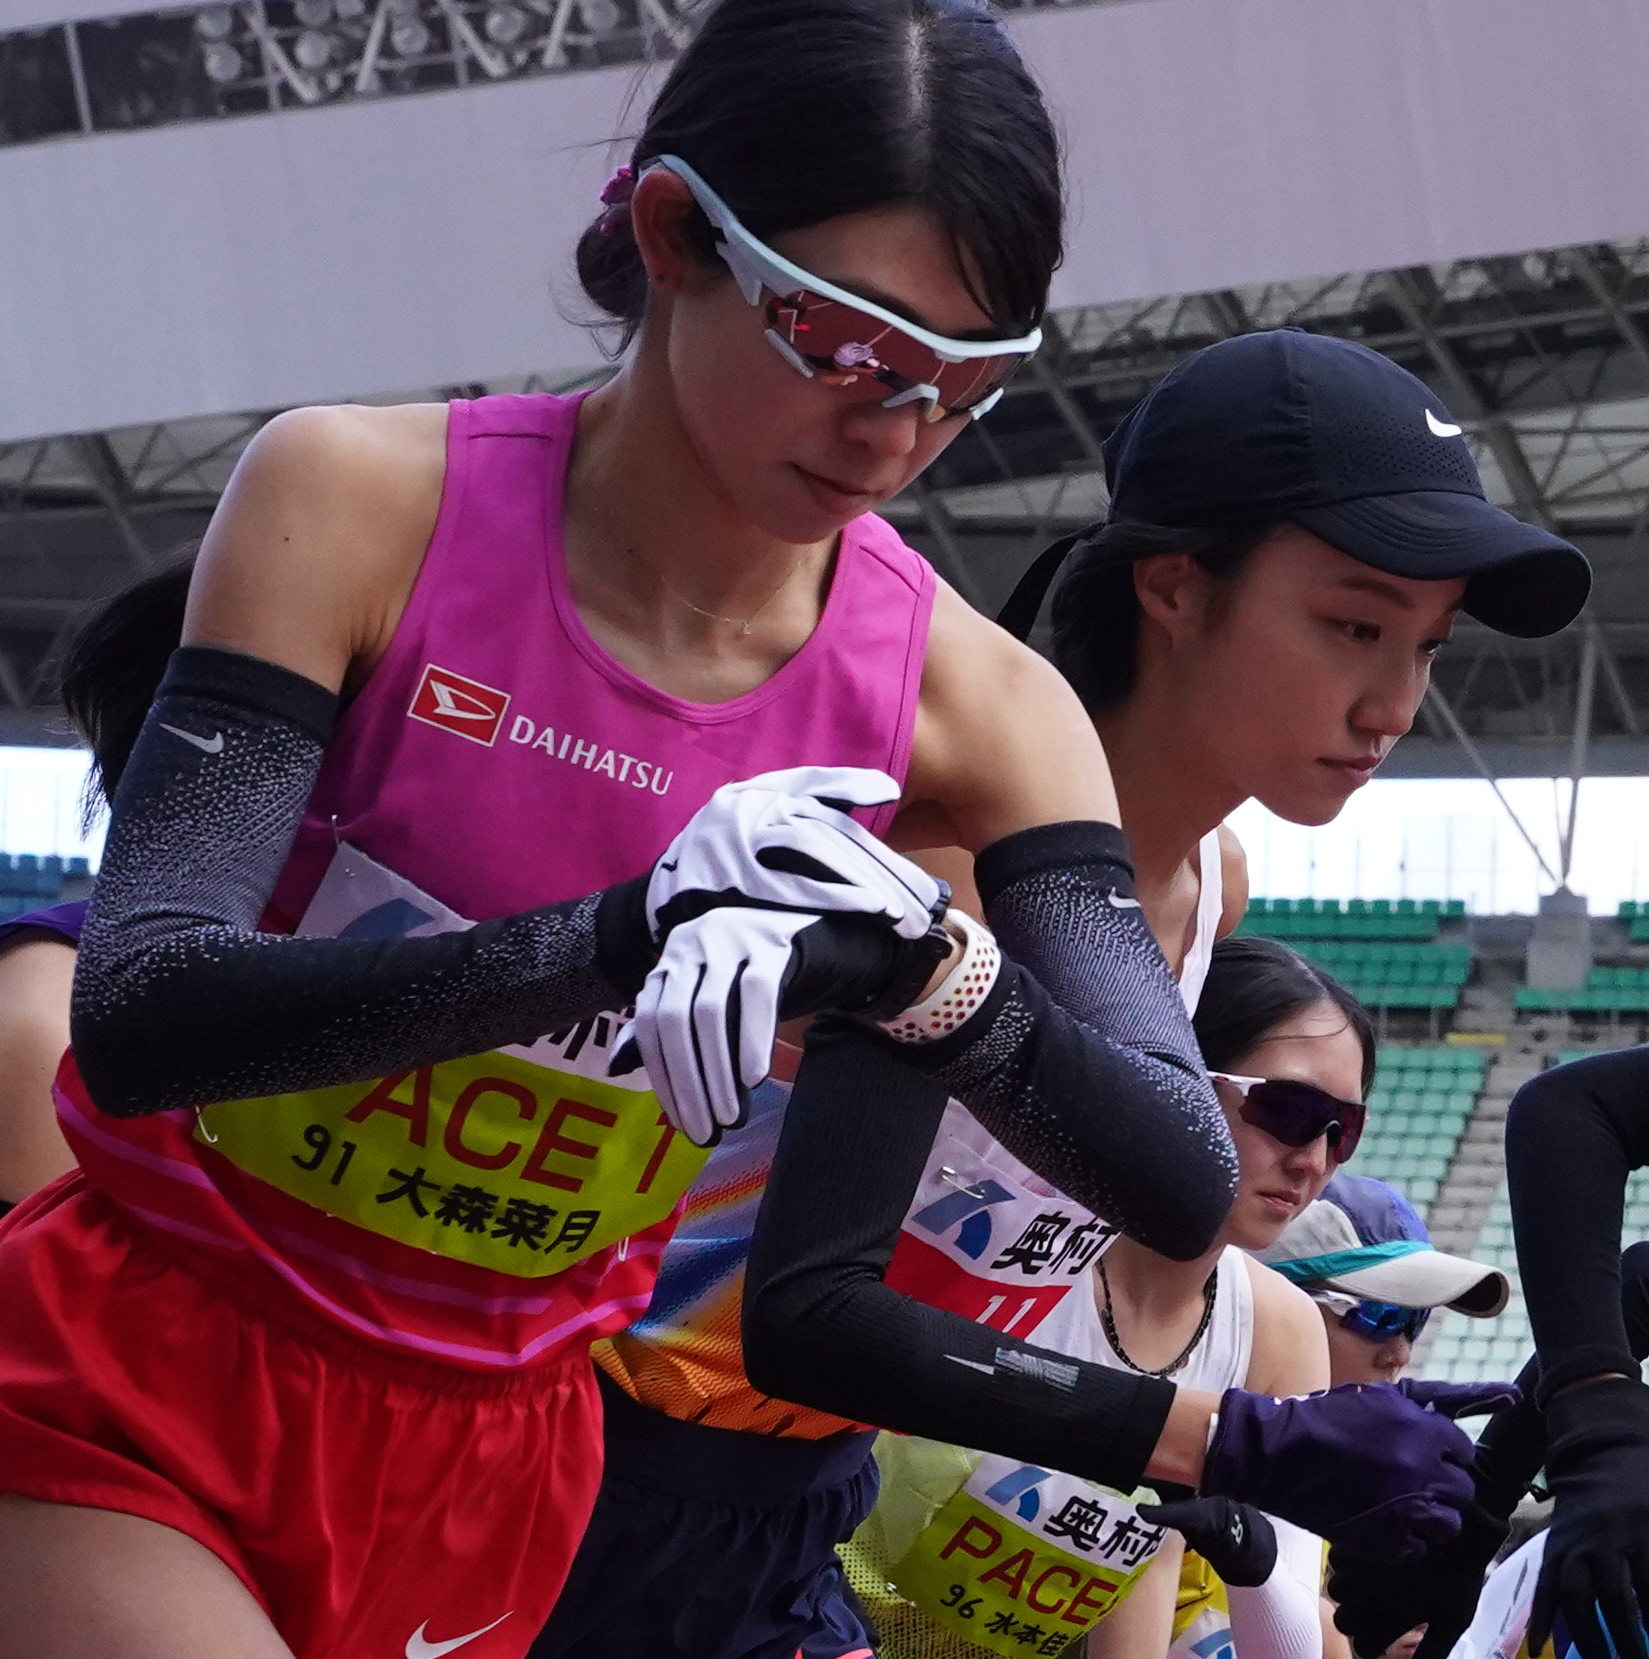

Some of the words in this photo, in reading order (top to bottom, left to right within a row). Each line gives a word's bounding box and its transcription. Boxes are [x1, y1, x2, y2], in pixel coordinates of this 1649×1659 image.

[509, 714, 674, 796] DAIHATSU
[291, 1123, 357, 1187] 91
[375, 1166, 602, 1255] 大森菜月
[974, 1294, 1038, 1334] 11
[1042, 1495, 1168, 1568] 奥村
[938, 1515, 1121, 1627] PACE
[939, 1583, 984, 1620] 96
[983, 1610, 1086, 1657] 水本佳
